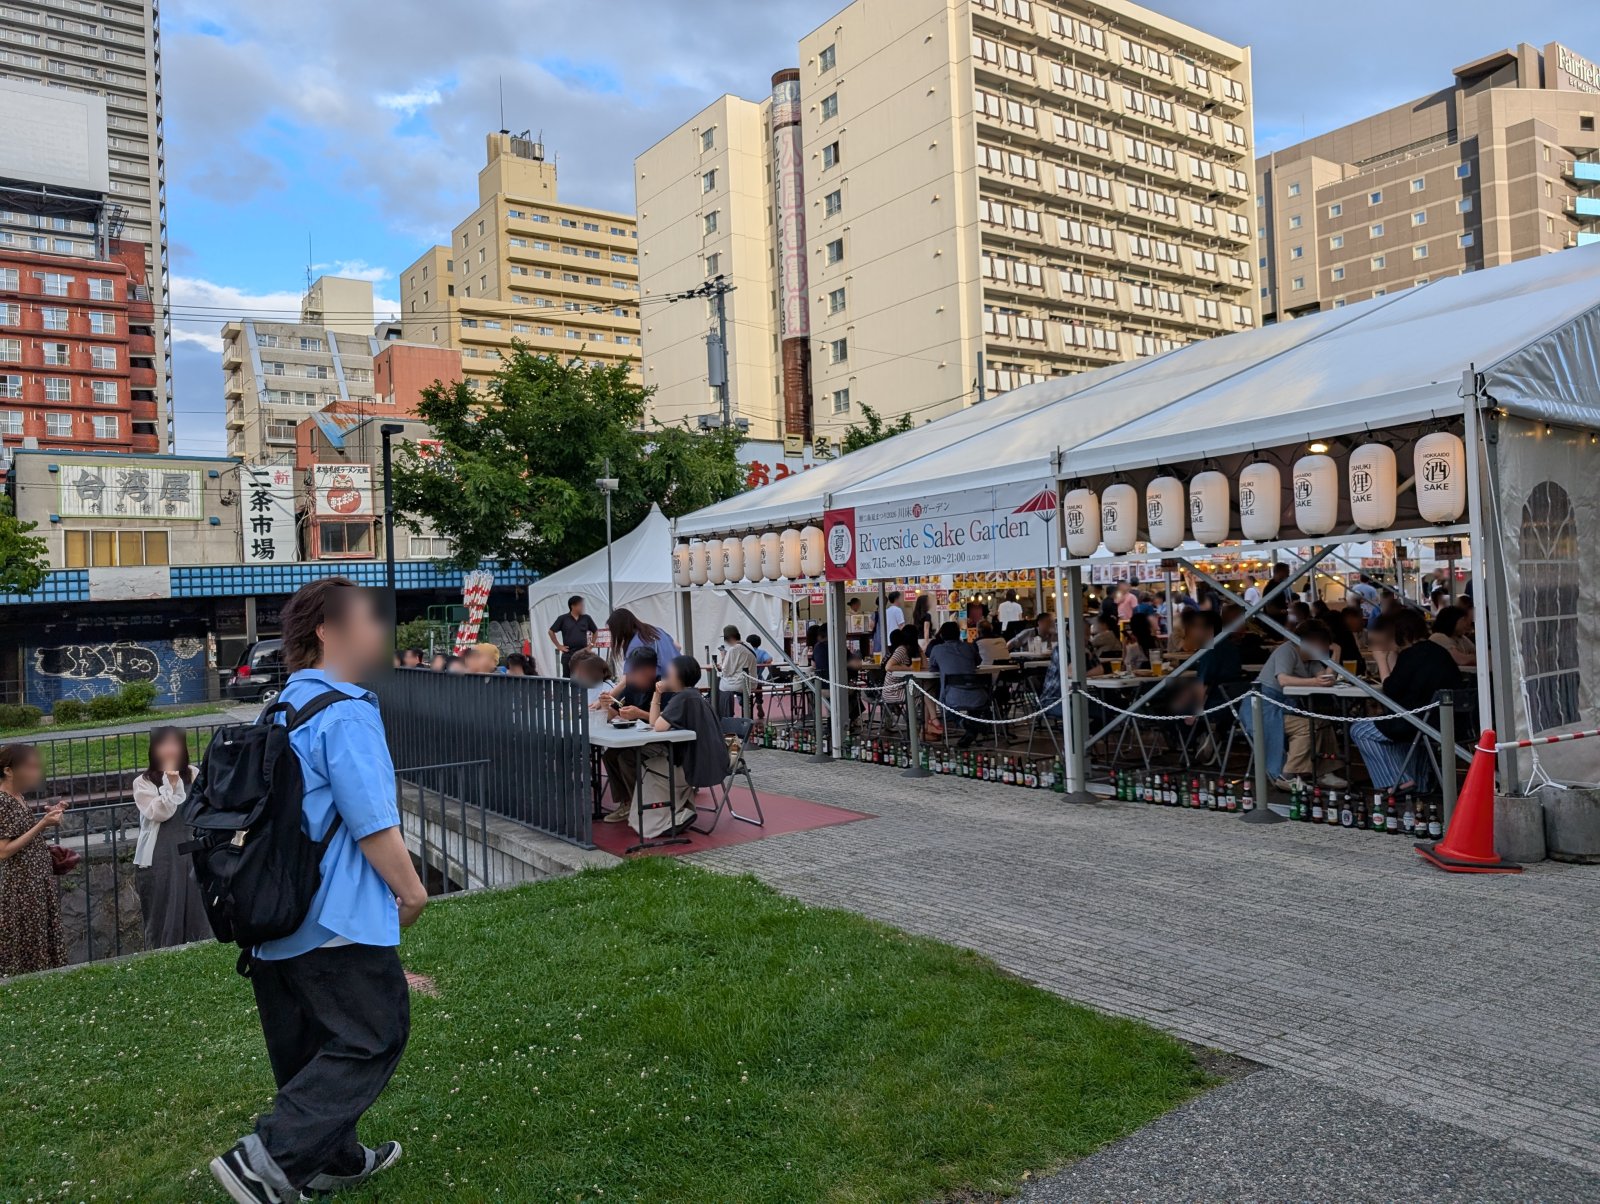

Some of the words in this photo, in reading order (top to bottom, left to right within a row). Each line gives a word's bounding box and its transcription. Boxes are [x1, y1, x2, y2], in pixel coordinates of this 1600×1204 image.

[1351, 463, 1372, 471] TANUKI
[274, 469, 290, 485] 新
[1424, 482, 1449, 491] SAKE
[1352, 494, 1372, 503] SAKE
[1295, 499, 1312, 508] SAKE
[248, 470, 275, 560] 二条市場
[859, 528, 919, 553] Riverside
[923, 521, 965, 549] Sake
[969, 516, 1030, 542] Garden
